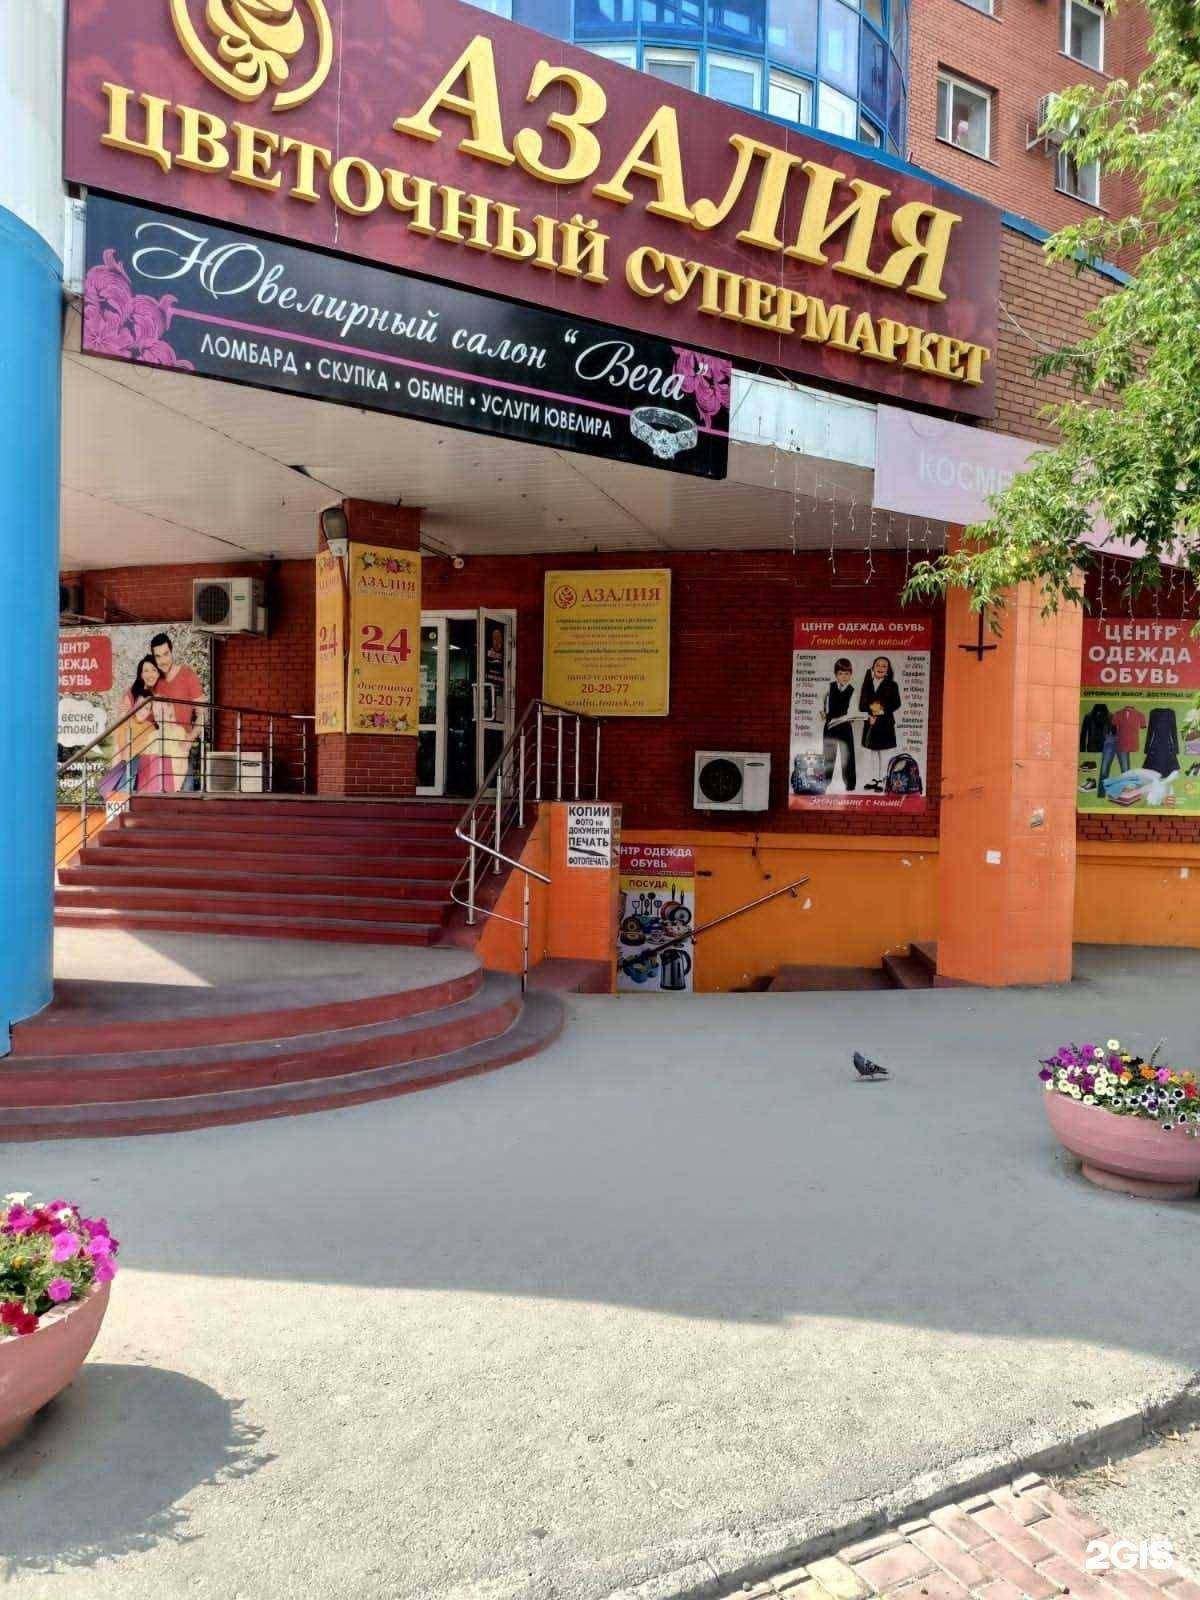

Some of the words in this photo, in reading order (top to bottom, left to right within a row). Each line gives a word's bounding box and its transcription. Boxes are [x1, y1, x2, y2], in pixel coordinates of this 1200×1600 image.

[394, 34, 962, 302] АЗАЛИЯ
[100, 82, 610, 284] ЦВЕТОЧНЫЙ
[624, 245, 992, 388] СУПЕРМАРКЕТ
[131, 222, 440, 342] Ювелирный
[450, 326, 548, 370] салон
[200, 333, 299, 375] ЛОМБАРД
[317, 357, 389, 392] СКУПКА
[407, 377, 465, 408] ОБМЕН
[480, 393, 541, 425] УСЛУГИ
[544, 409, 613, 439] ЮВЕЛИРА
[358, 574, 416, 592] АЗАЛИЯ
[582, 587, 661, 602] АЗАЛИЯ
[801, 622, 835, 633] ЦЕНТР
[838, 622, 886, 633] ОДЕЖДА
[888, 622, 926, 632] ОБУВЬ
[1104, 624, 1178, 643] ЦЕНТР
[360, 624, 412, 662] 24
[362, 651, 400, 665] ЧАСА
[1088, 646, 1192, 665] ОДЕЖДА
[1100, 667, 1180, 684] ОБУВЬ
[581, 683, 630, 694] 20-20-77
[358, 693, 412, 706] 20-20-77
[58, 722, 98, 734] отовы!
[568, 806, 610, 817] КОПИИ
[575, 818, 594, 826] ФОТО
[568, 827, 610, 836] ДОКУМЕНТЫ
[568, 837, 610, 847] ПЕЧАТЬ
[617, 846, 641, 855] НТР
[643, 847, 693, 857] ОДЕЖДА
[568, 857, 609, 866] ФОТОПЕЧАТЬ
[630, 858, 668, 868] ОБУВЬ
[629, 879, 669, 889] ПОСУДА
